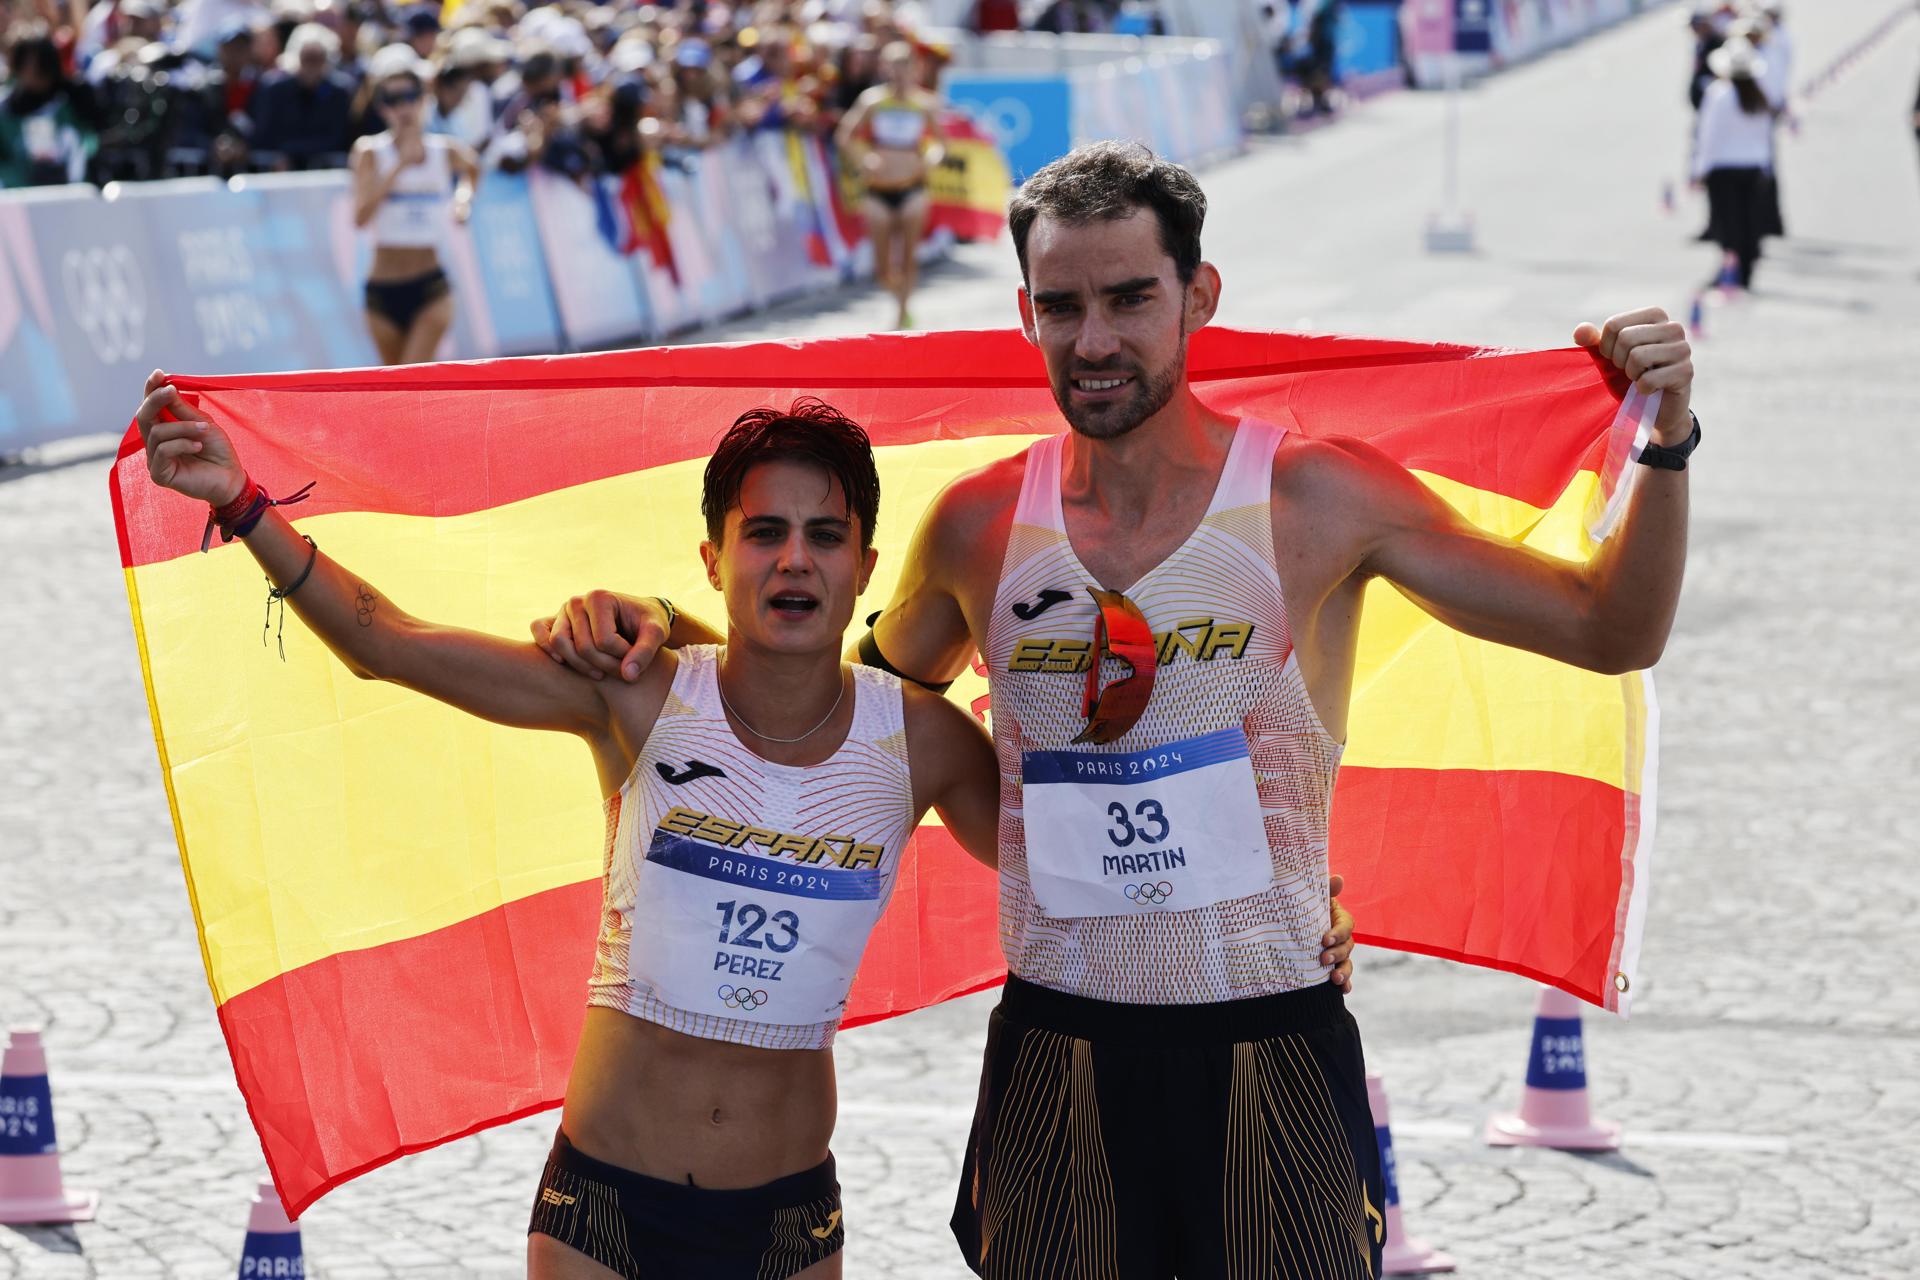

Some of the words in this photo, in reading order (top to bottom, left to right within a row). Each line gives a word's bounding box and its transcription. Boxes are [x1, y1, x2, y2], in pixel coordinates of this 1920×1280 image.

[1129, 752, 1183, 775] 2024
[657, 806, 885, 870] ESPAÑA
[1107, 799, 1170, 848] 33
[1103, 847, 1187, 875] MARTIN
[776, 872, 829, 891] 2024
[716, 900, 800, 954] 123
[713, 952, 785, 982] PEREZ
[543, 1187, 577, 1206] ESP
